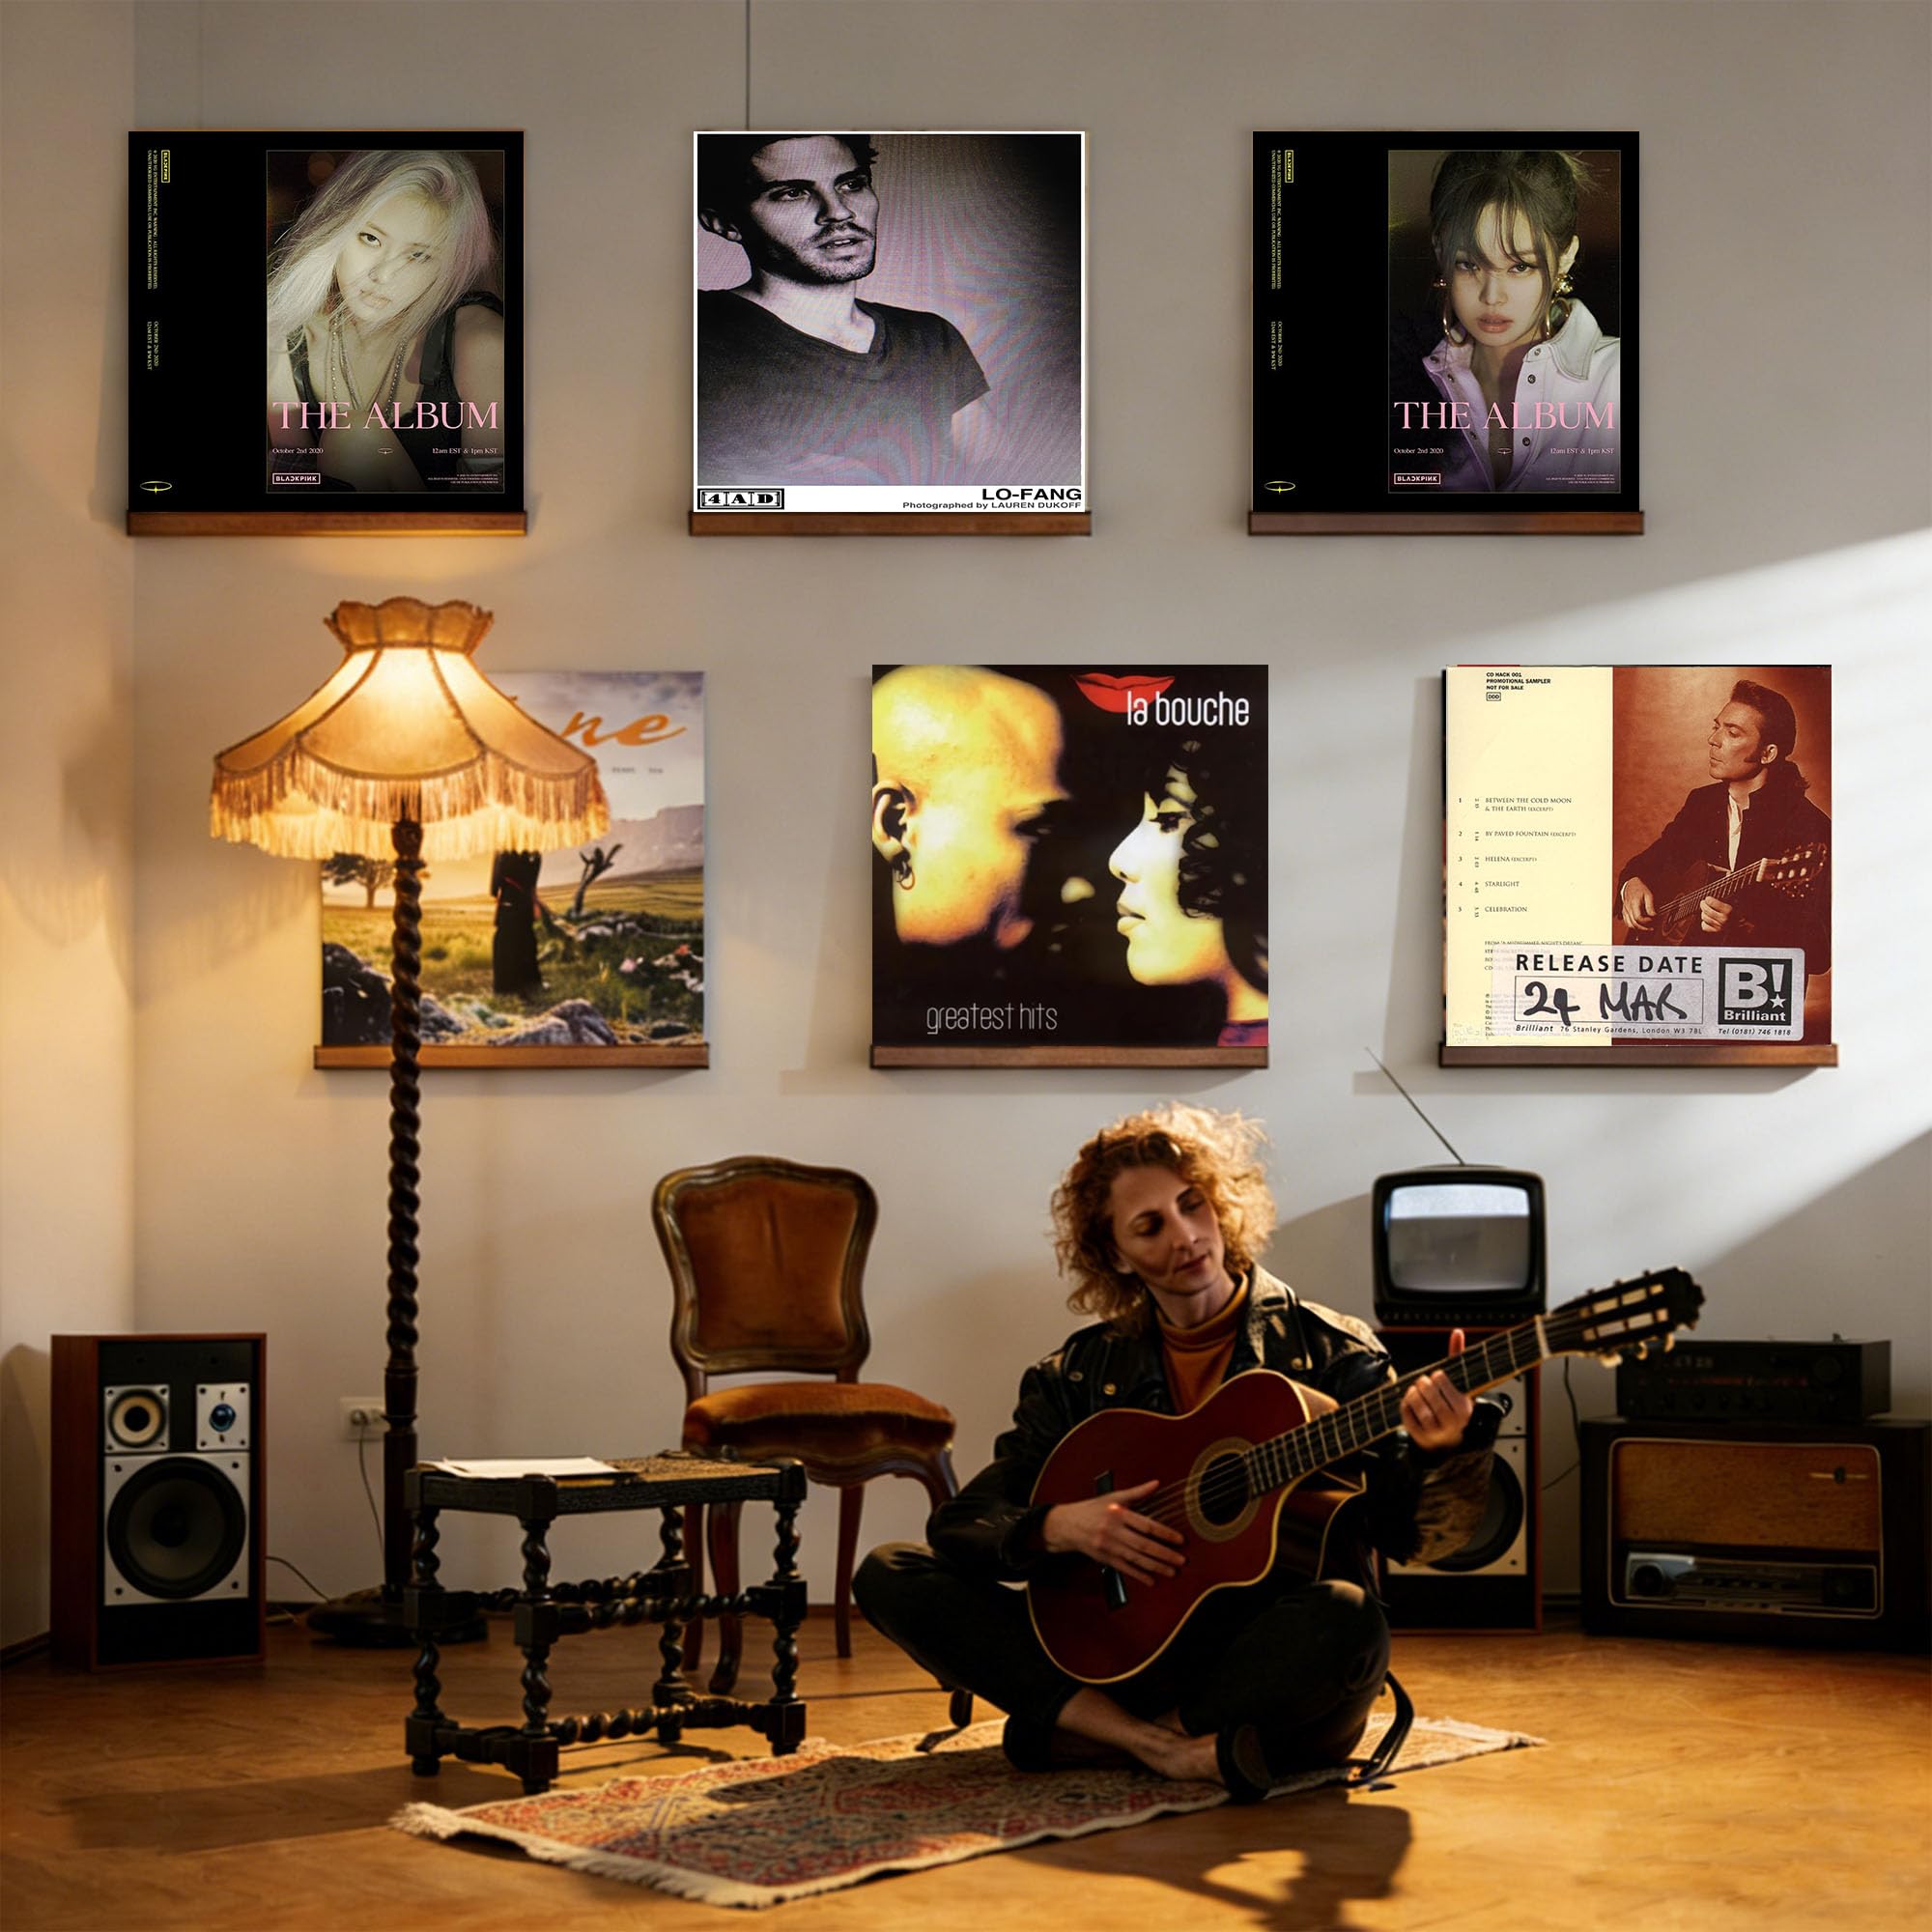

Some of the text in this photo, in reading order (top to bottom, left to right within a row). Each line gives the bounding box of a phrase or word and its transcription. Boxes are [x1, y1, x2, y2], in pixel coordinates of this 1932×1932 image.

[272, 401, 498, 430] THE ALBUM
[1394, 401, 1615, 430] THE ALBUM
[470, 447, 483, 456] 1pm
[1587, 447, 1600, 456] 1pm
[708, 494, 774, 504] 4AD
[982, 488, 1082, 500] LO-FANG
[902, 501, 974, 510] Photographed
[976, 501, 988, 510] by
[1127, 691, 1249, 725] la bouche
[561, 710, 687, 748] ne
[1516, 953, 1703, 974] RELEASE DATE
[1523, 980, 1580, 1026] 24
[1599, 981, 1688, 1021] MAR
[926, 1003, 1058, 1035] greatest hits
[1724, 1009, 1786, 1023] Brilliant
